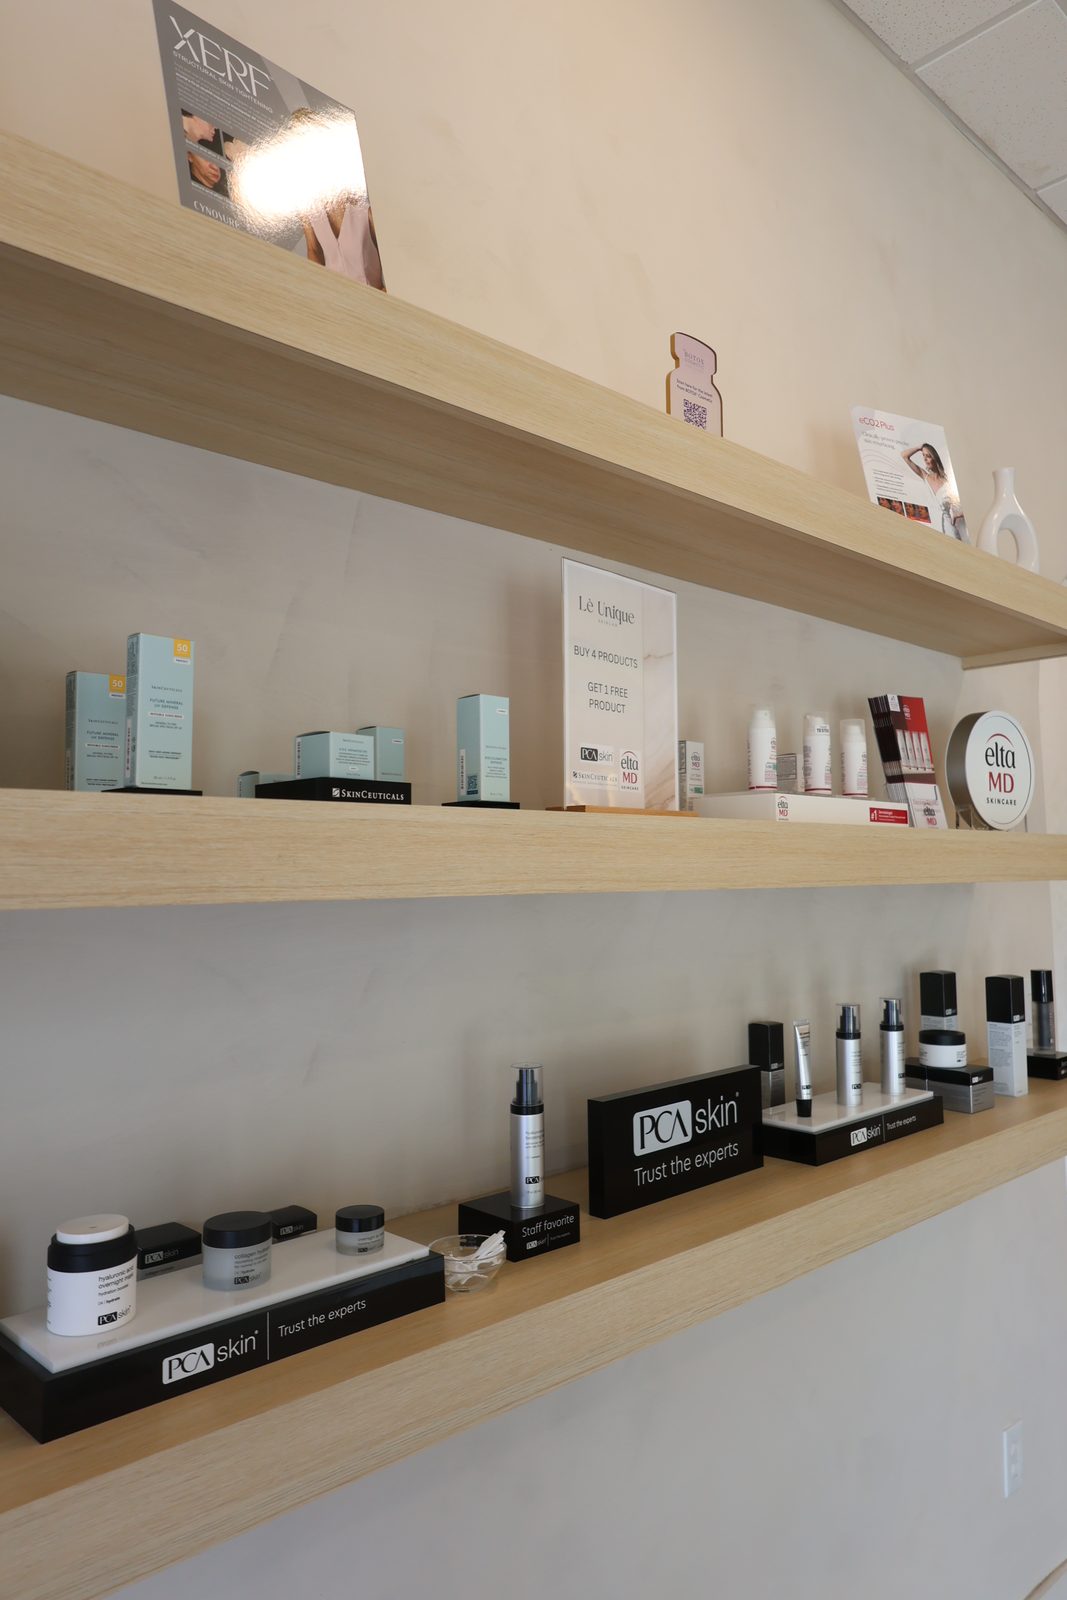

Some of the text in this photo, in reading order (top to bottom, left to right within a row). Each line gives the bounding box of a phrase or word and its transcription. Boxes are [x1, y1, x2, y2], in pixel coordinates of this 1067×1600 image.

[170, 16, 272, 96] XERF
[173, 51, 274, 114] STRUCTURAL SKIN TIGHTENING
[598, 601, 635, 624] Unique
[176, 644, 188, 652] 50
[574, 645, 638, 668] BUY 4 PRODUCTS
[588, 682, 628, 698] GET 1 FREE
[588, 699, 626, 714] PRODUCT
[582, 748, 612, 762] PCA skin
[620, 756, 638, 770] elta
[984, 741, 1016, 768] elta
[622, 772, 638, 784] MD
[988, 771, 1015, 794] MD
[778, 800, 788, 808] elta
[986, 797, 1017, 806] SKINCARE
[778, 808, 788, 816] MD
[640, 1096, 738, 1150] PCA skin
[852, 1125, 880, 1145] PCA skin
[634, 1142, 739, 1186] Trust the experts
[526, 1176, 540, 1184] PCA
[522, 1221, 542, 1238] Staff
[544, 1215, 574, 1230] favorite
[100, 1312, 117, 1324] PCA
[278, 1300, 366, 1338] Trust the experts
[168, 1333, 256, 1380] PCA skin
